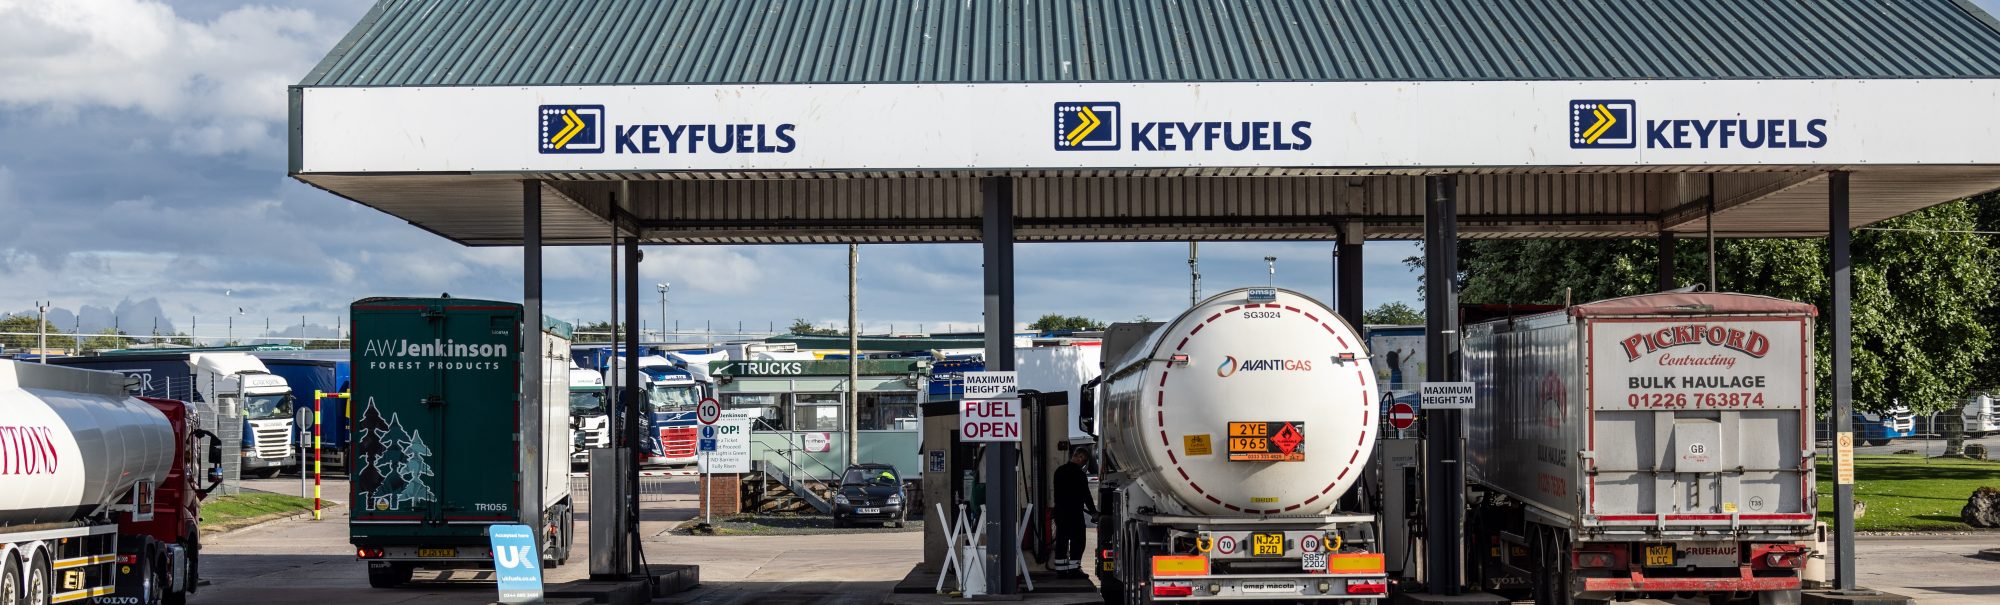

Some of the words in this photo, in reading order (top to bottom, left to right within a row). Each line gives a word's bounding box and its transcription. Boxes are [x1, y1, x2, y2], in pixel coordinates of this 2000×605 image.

[615, 124, 796, 154] KEYFUELS
[1131, 121, 1312, 151] KEYFUELS
[1647, 119, 1827, 149] KEYFUELS
[1620, 325, 1770, 363] PICKFORD
[370, 362, 421, 370] FOREST
[429, 362, 499, 370] PRODUCTS
[1240, 359, 1312, 371] AVANTIGAS
[1659, 353, 1736, 369] Contracting
[738, 362, 802, 375] TRUCKS
[966, 376, 1015, 384] MAXIMUM
[1628, 377, 1676, 389] BULK
[1682, 376, 1766, 388] HAULAGE
[965, 385, 1000, 394] HEIGHT
[1002, 385, 1016, 393] 5M
[1424, 386, 1472, 394] MAXIMUM
[1423, 396, 1457, 404] HEIGHT
[1459, 396, 1474, 404] 5M
[1628, 393, 1687, 407] 01226
[1693, 393, 1764, 407] 763874
[702, 405, 716, 417] 10
[965, 402, 1015, 417] FUEL
[964, 422, 1018, 438] OPEN
[1240, 424, 1266, 434] 2YE
[1232, 438, 1266, 449] 1965
[1691, 445, 1704, 454] GB
[475, 503, 507, 511] TR1055
[1222, 541, 1232, 549] 70
[1256, 536, 1281, 544] NJ23
[1305, 540, 1316, 548] 80
[1260, 545, 1278, 553] BZD
[496, 546, 535, 568] UK
[1304, 560, 1325, 568] 2202
[93, 596, 139, 604] VOLVO
